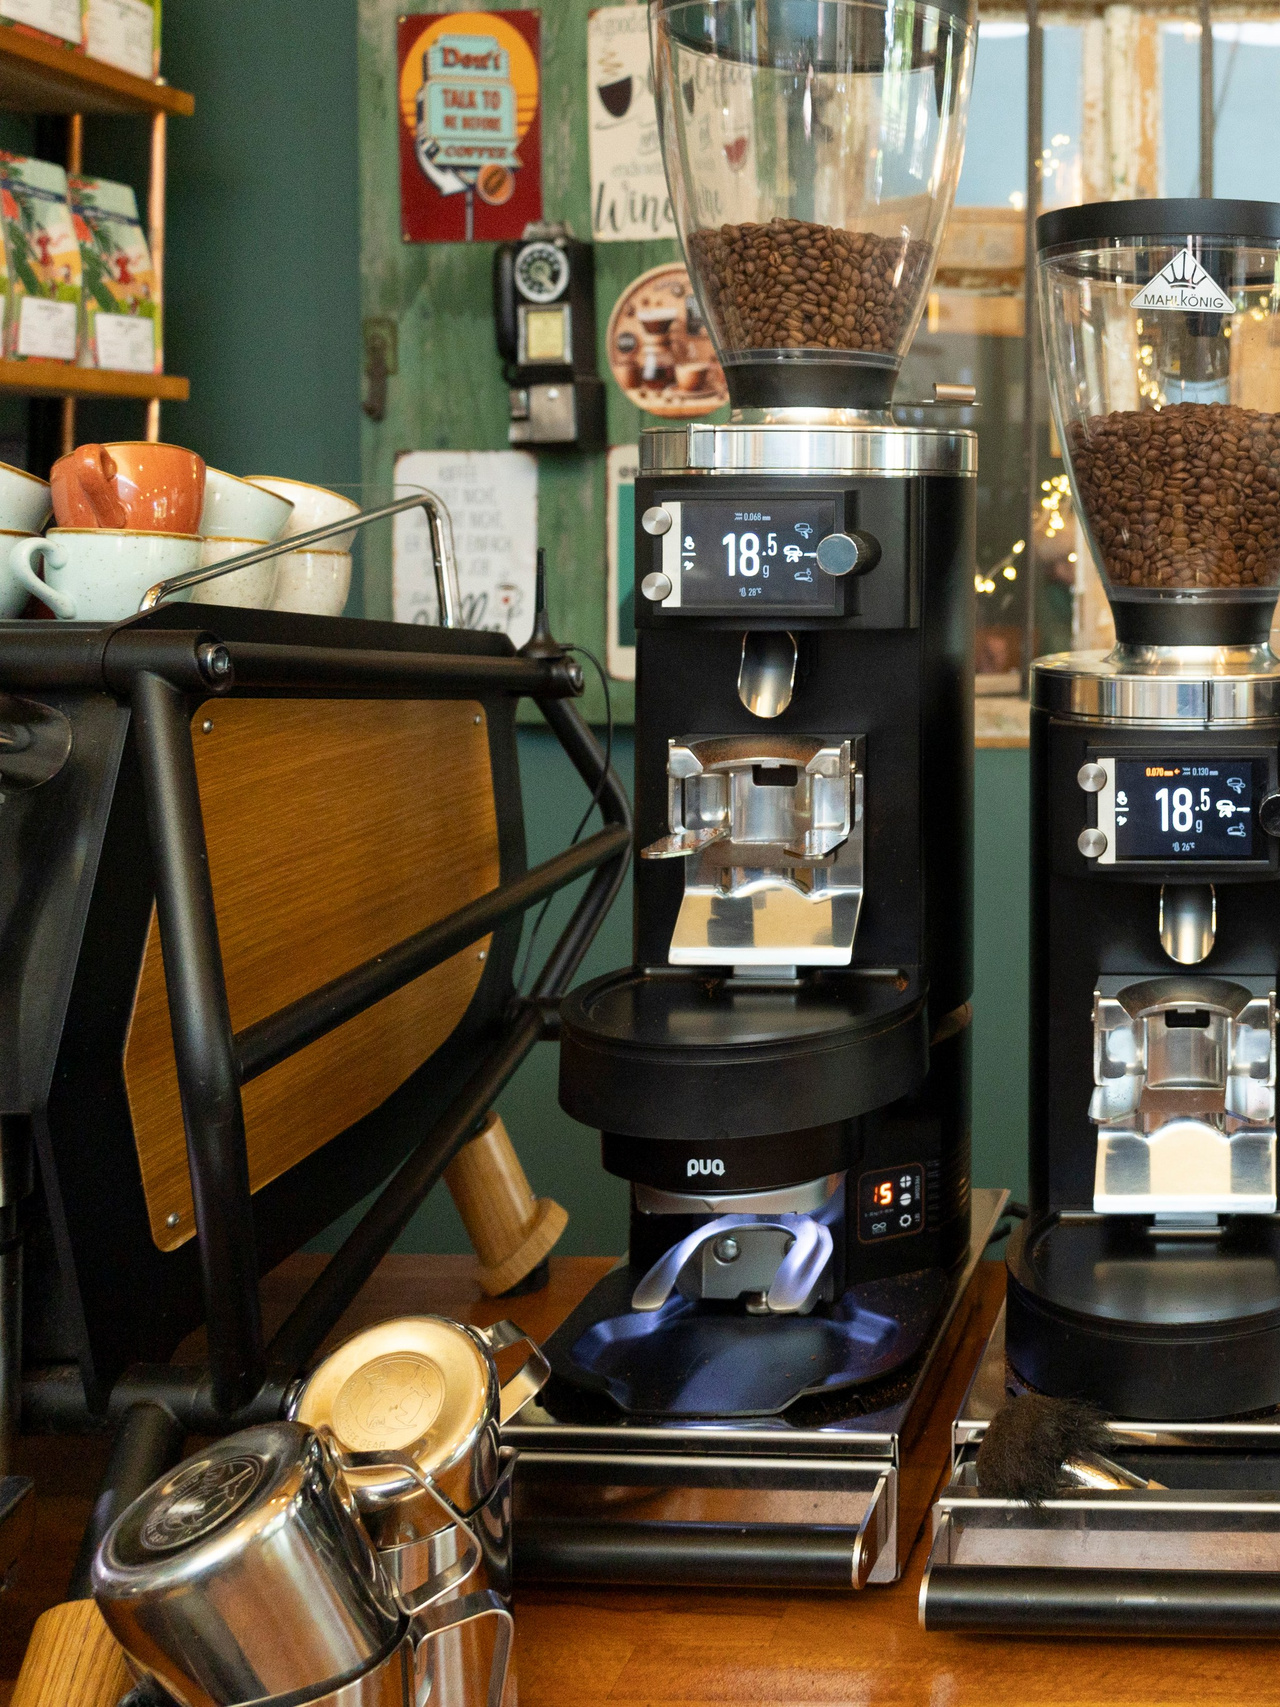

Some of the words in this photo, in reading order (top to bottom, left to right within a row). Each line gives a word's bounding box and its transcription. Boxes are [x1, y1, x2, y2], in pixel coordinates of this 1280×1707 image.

[442, 88, 478, 109] TALK
[482, 89, 502, 111] TO
[444, 145, 506, 159] COFFEE
[743, 512, 762, 522] 0.068
[1145, 767, 1164, 777] 0.070
[1192, 767, 1209, 776] 0.130
[873, 1181, 893, 1206] 15
